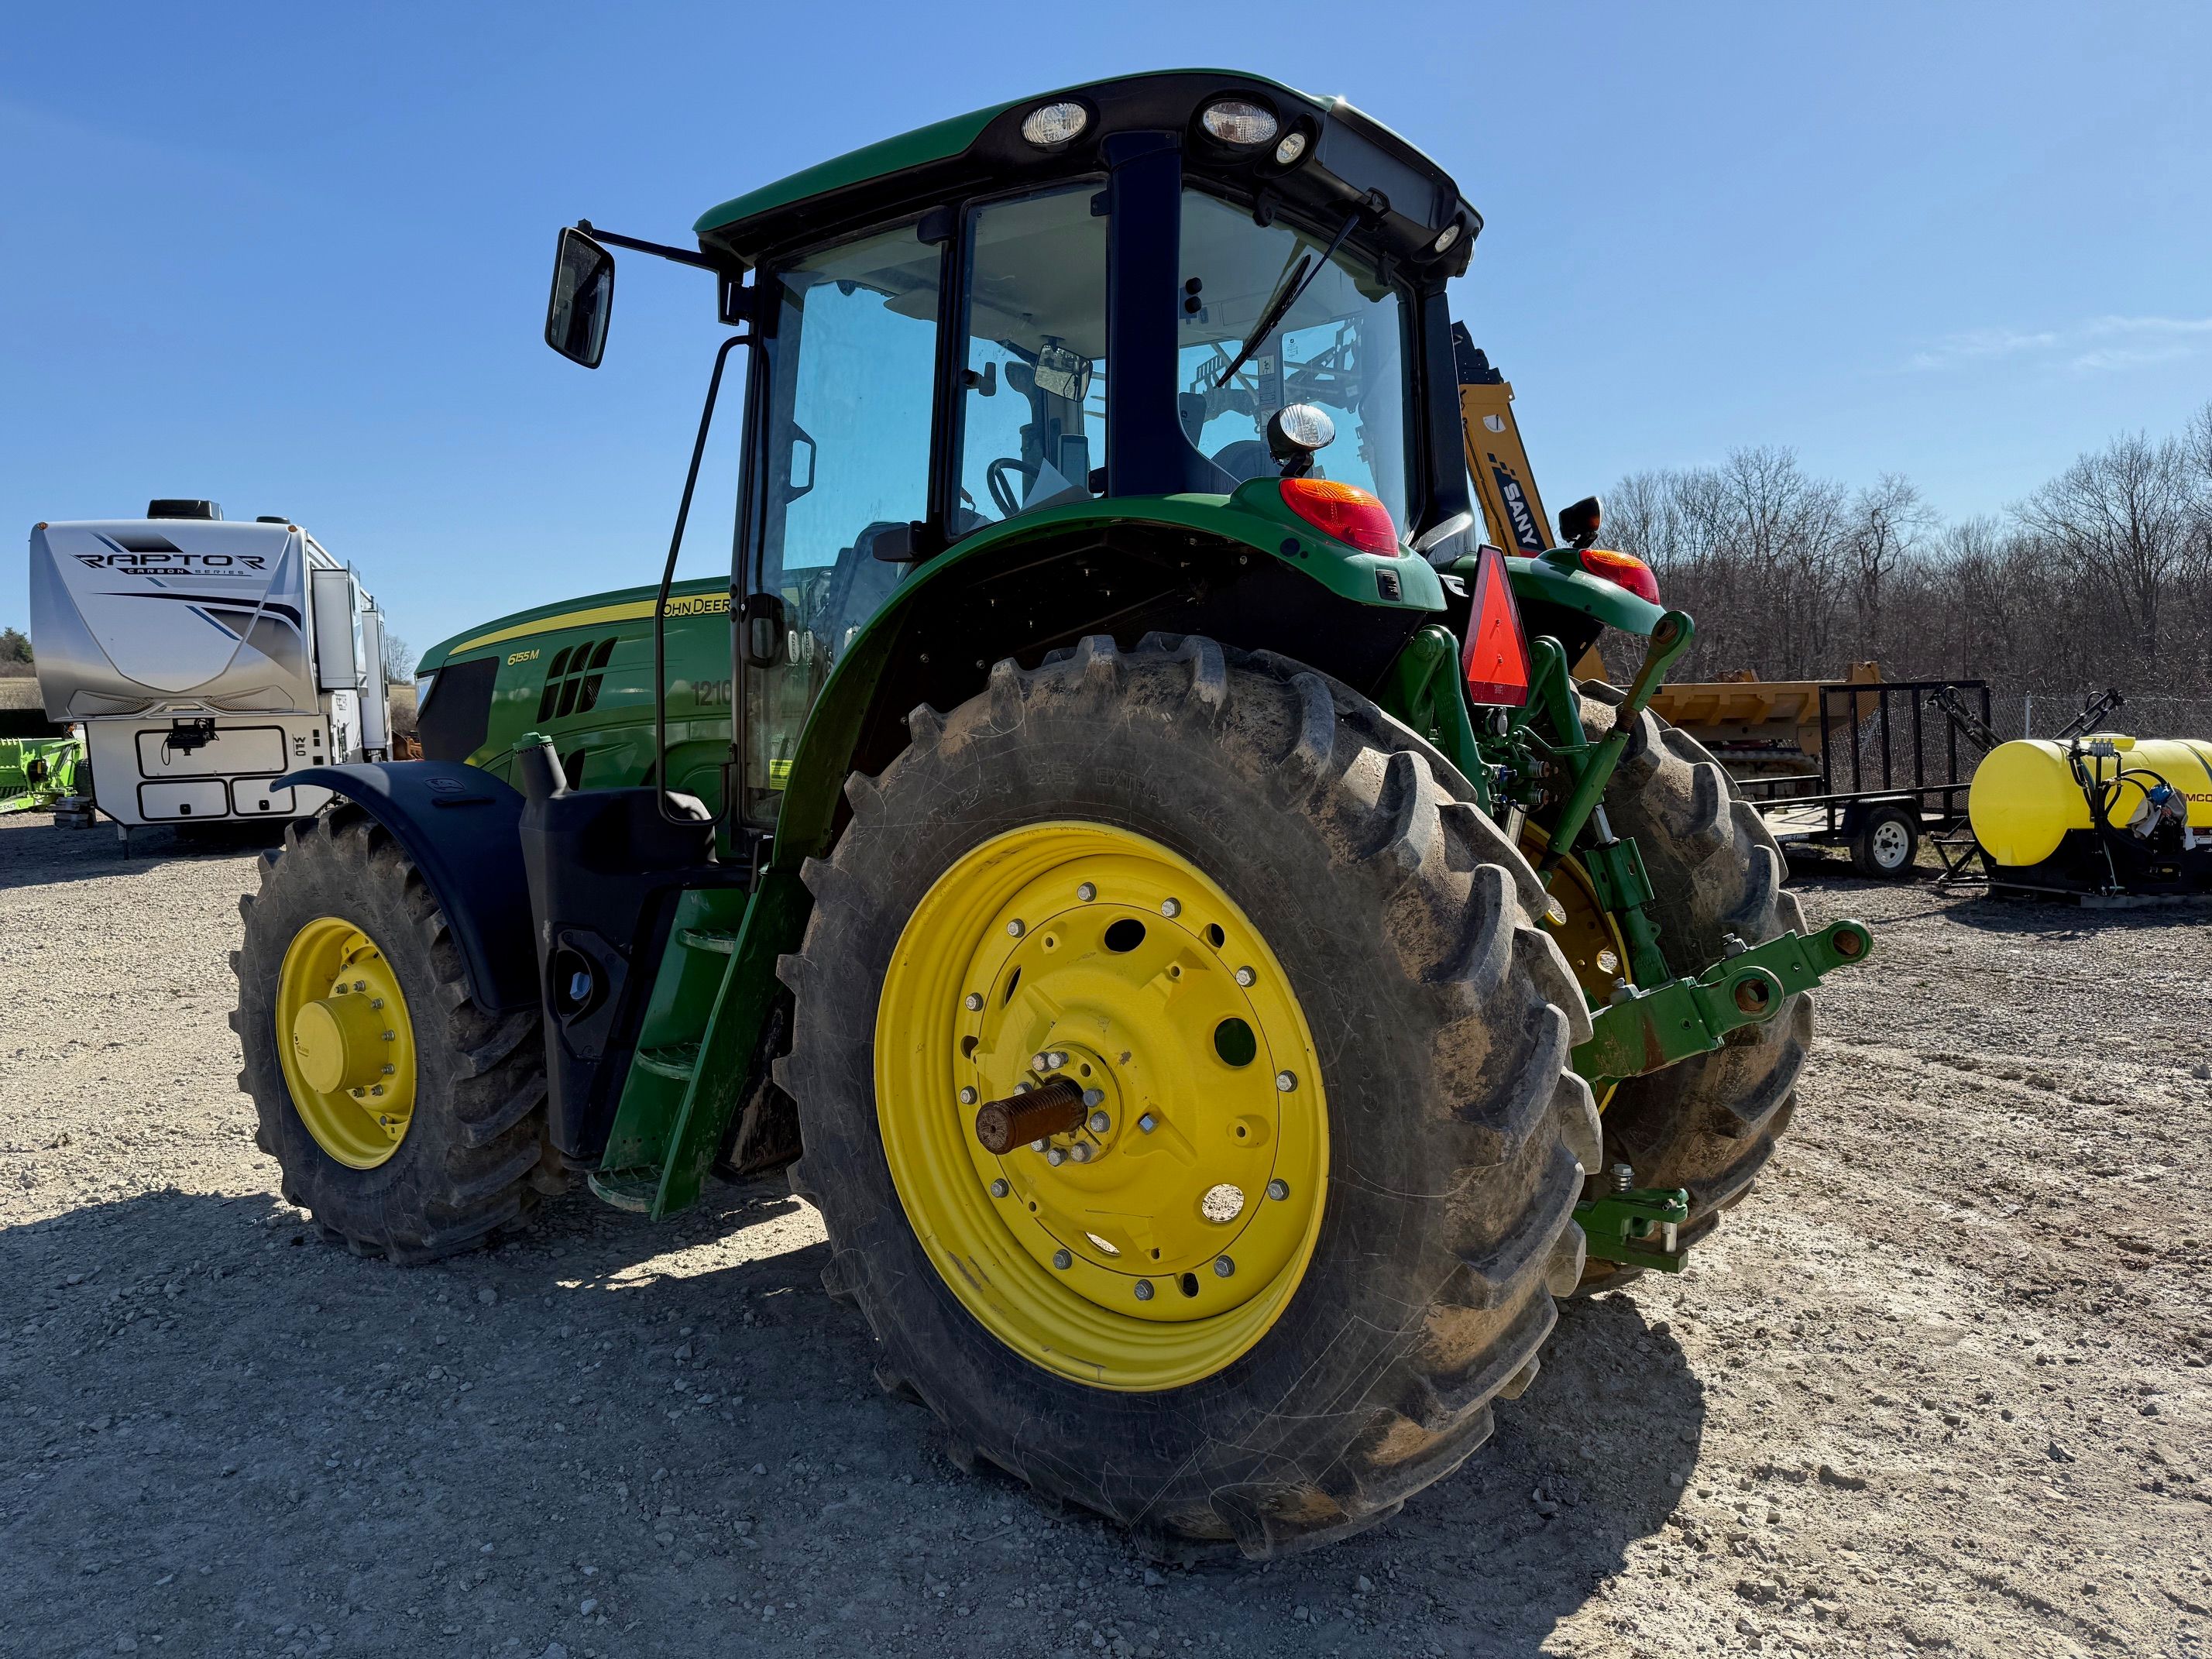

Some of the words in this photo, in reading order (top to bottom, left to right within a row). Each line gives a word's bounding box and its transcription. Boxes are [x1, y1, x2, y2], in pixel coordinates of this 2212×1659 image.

[1503, 483, 1537, 544] SANY
[70, 554, 268, 570] RAPTOR
[663, 602, 692, 616] OHN
[693, 598, 731, 613] DEER
[507, 649, 540, 666] 6155M
[691, 679, 732, 706] 1210
[294, 737, 307, 757] WFO
[2186, 793, 2212, 802] MCO
